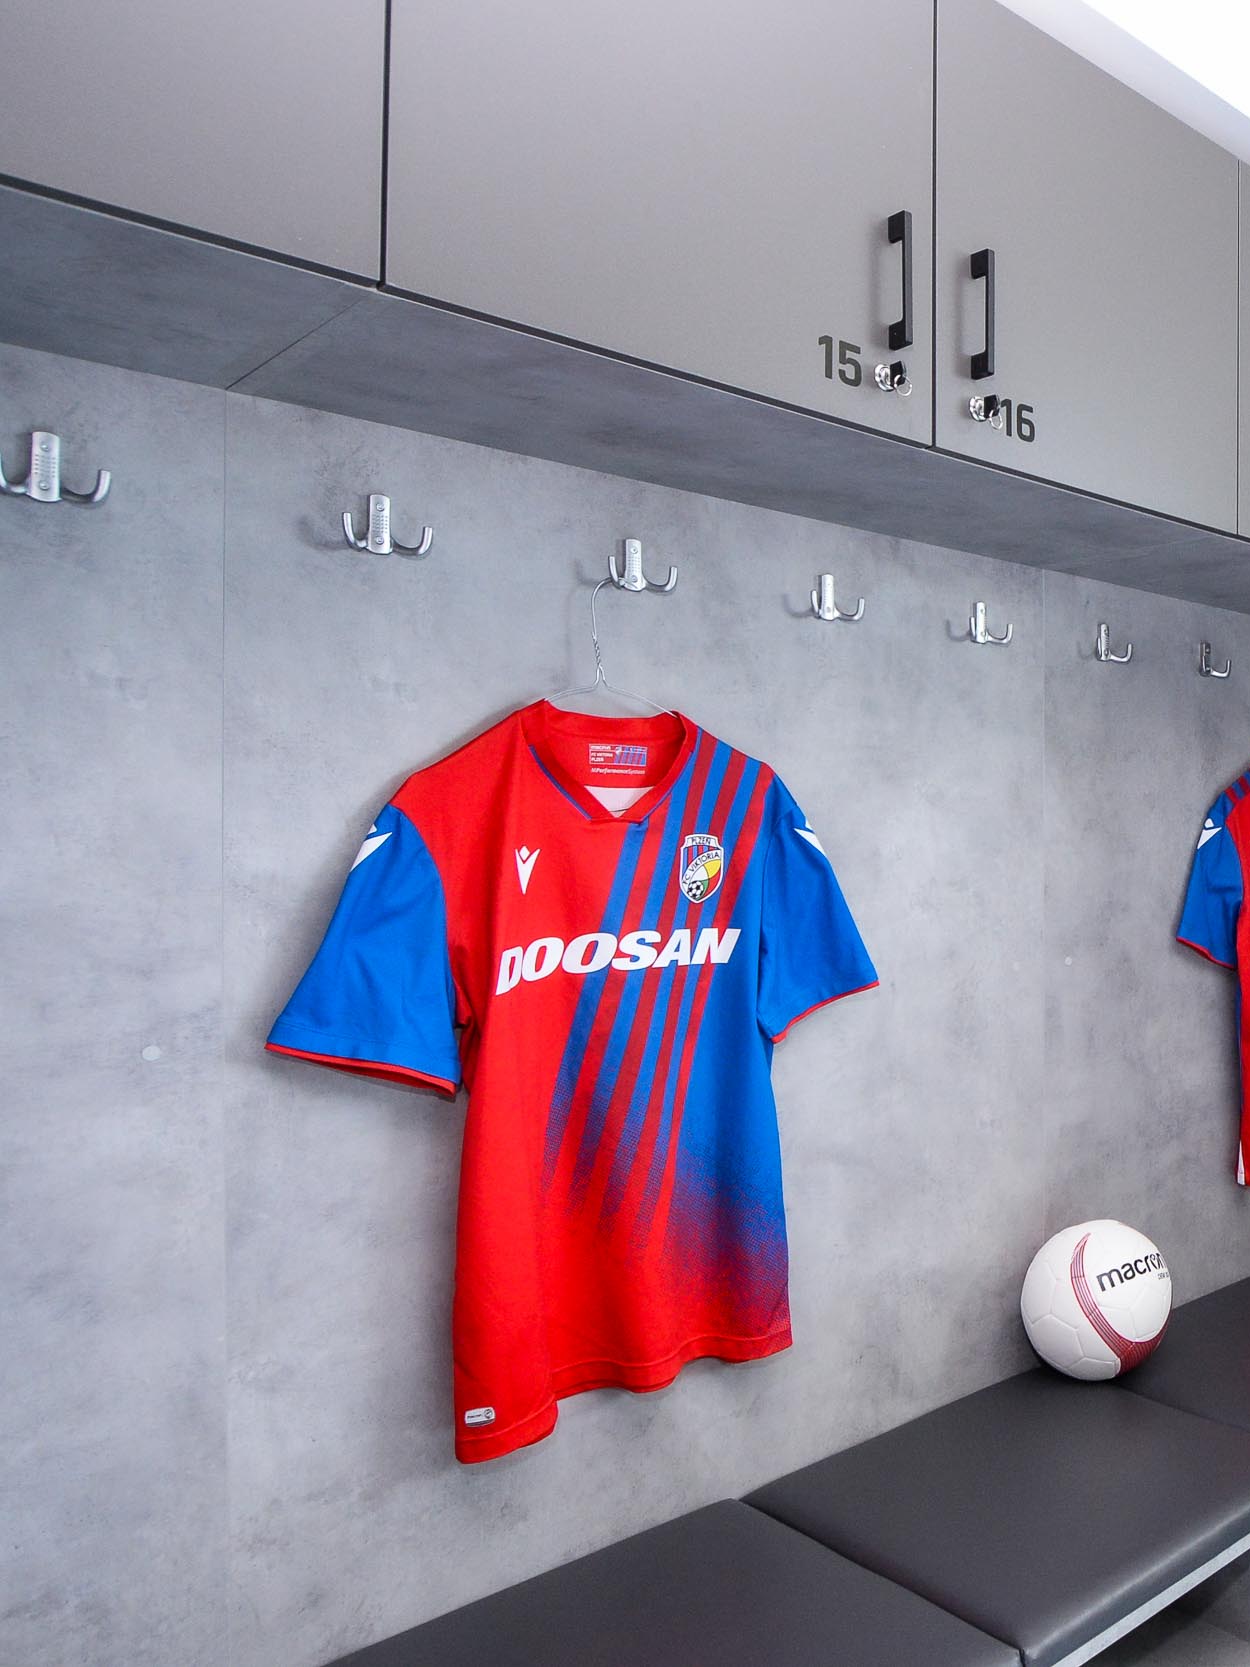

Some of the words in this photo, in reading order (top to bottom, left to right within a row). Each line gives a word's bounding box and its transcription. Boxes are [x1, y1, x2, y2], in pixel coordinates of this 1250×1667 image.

[818, 334, 862, 387] 15
[1000, 398, 1035, 443] 16
[689, 852, 720, 872] VIKTORIA
[496, 928, 742, 996] DOOSAN
